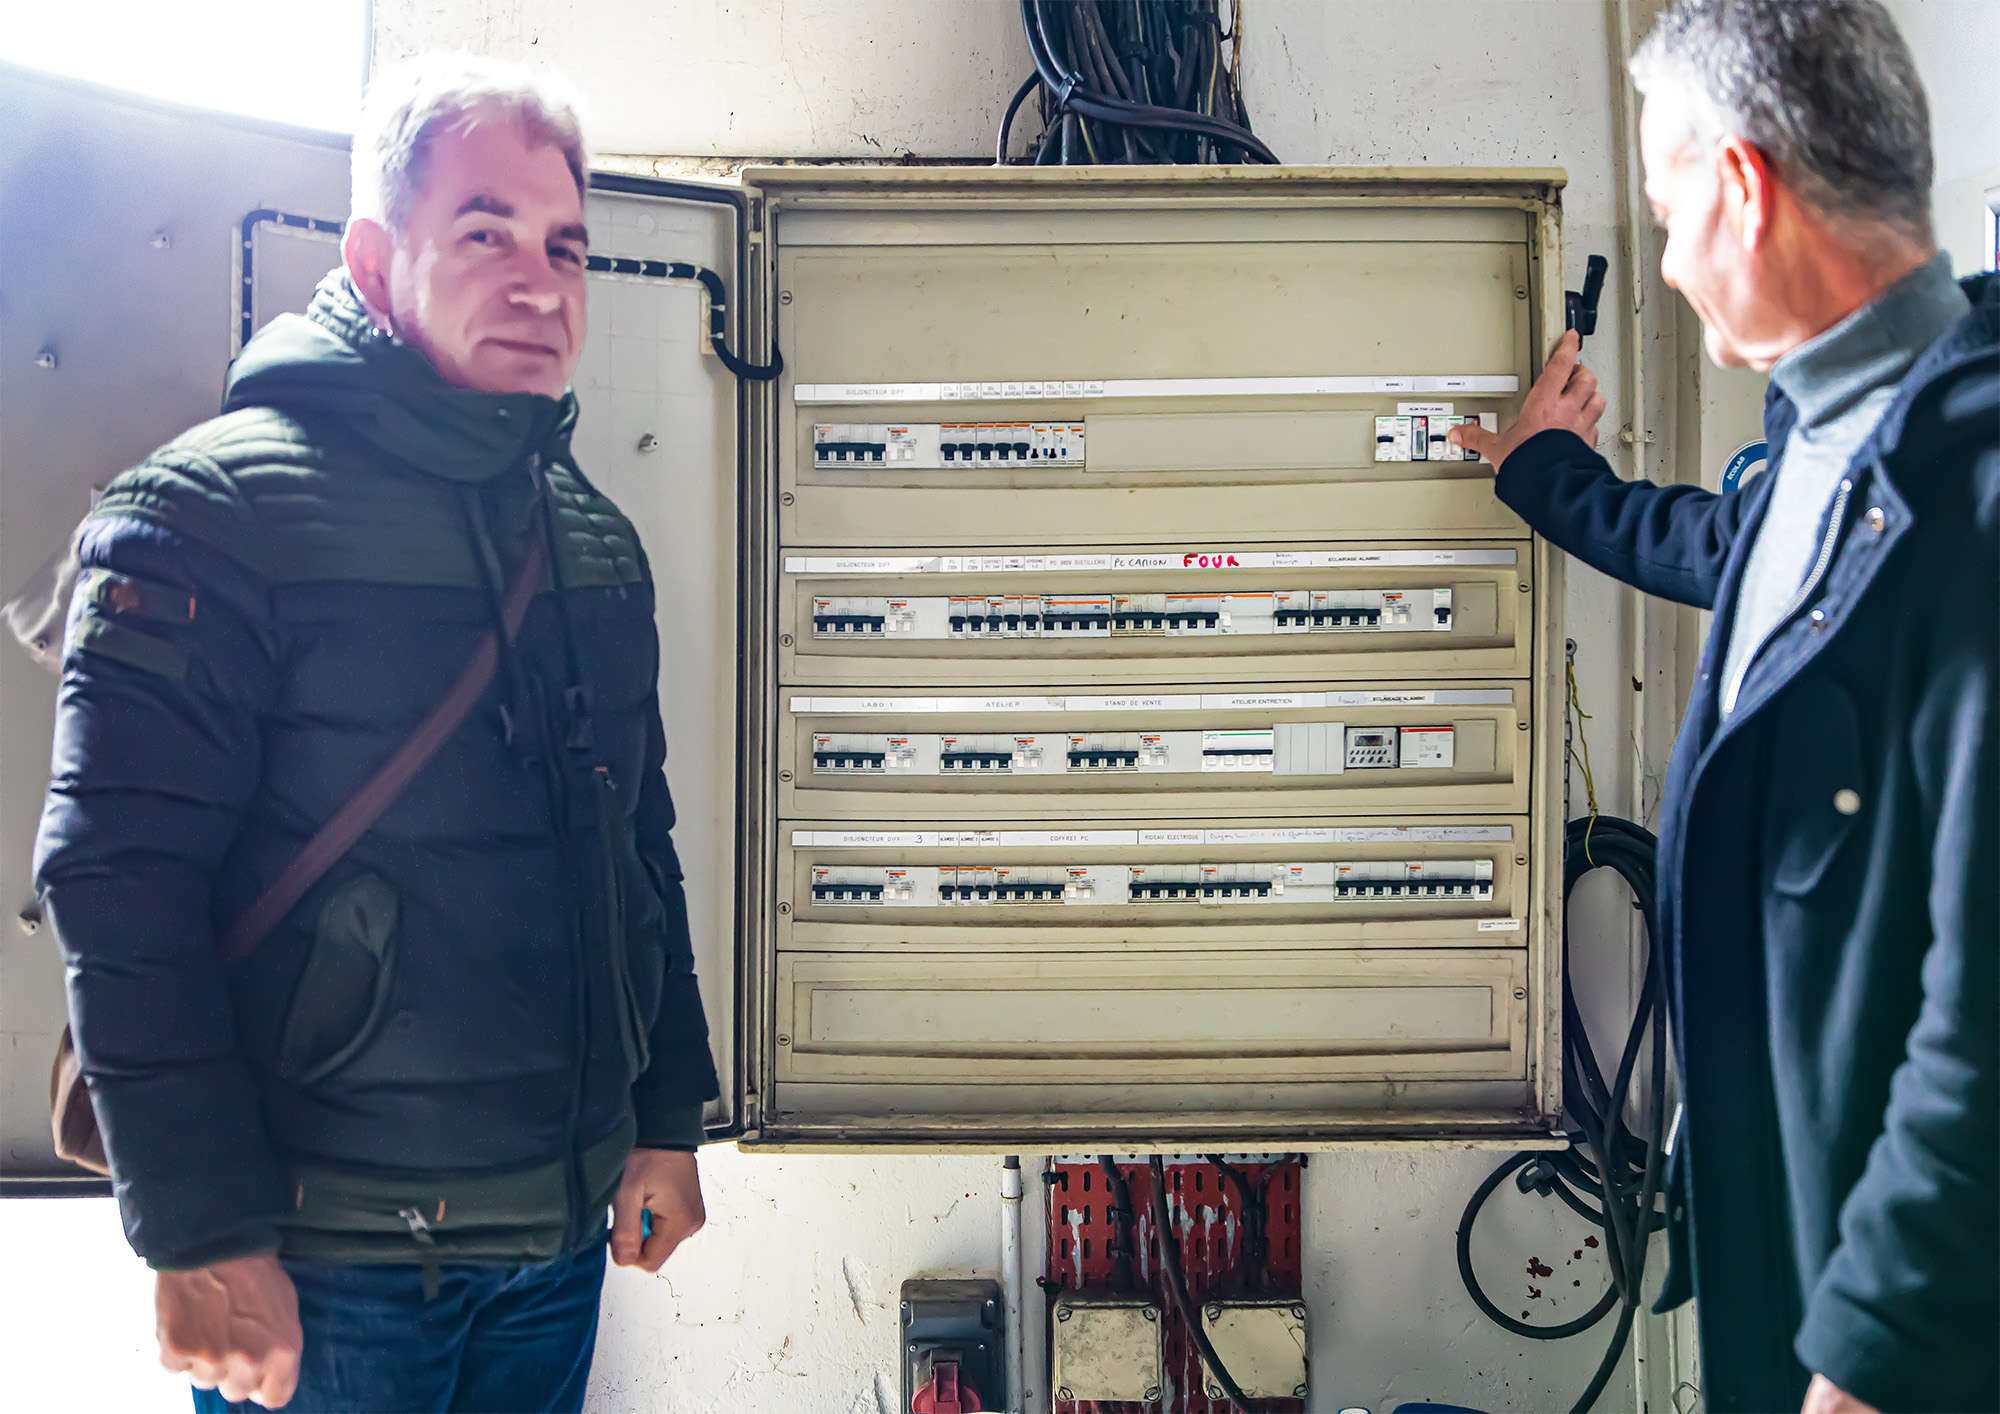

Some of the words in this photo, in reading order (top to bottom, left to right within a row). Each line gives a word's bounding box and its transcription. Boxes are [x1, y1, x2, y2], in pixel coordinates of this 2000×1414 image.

[1727, 456, 1745, 480] ECOLAB
[1184, 553, 1239, 568] FOUR
[915, 835, 923, 844] 3
